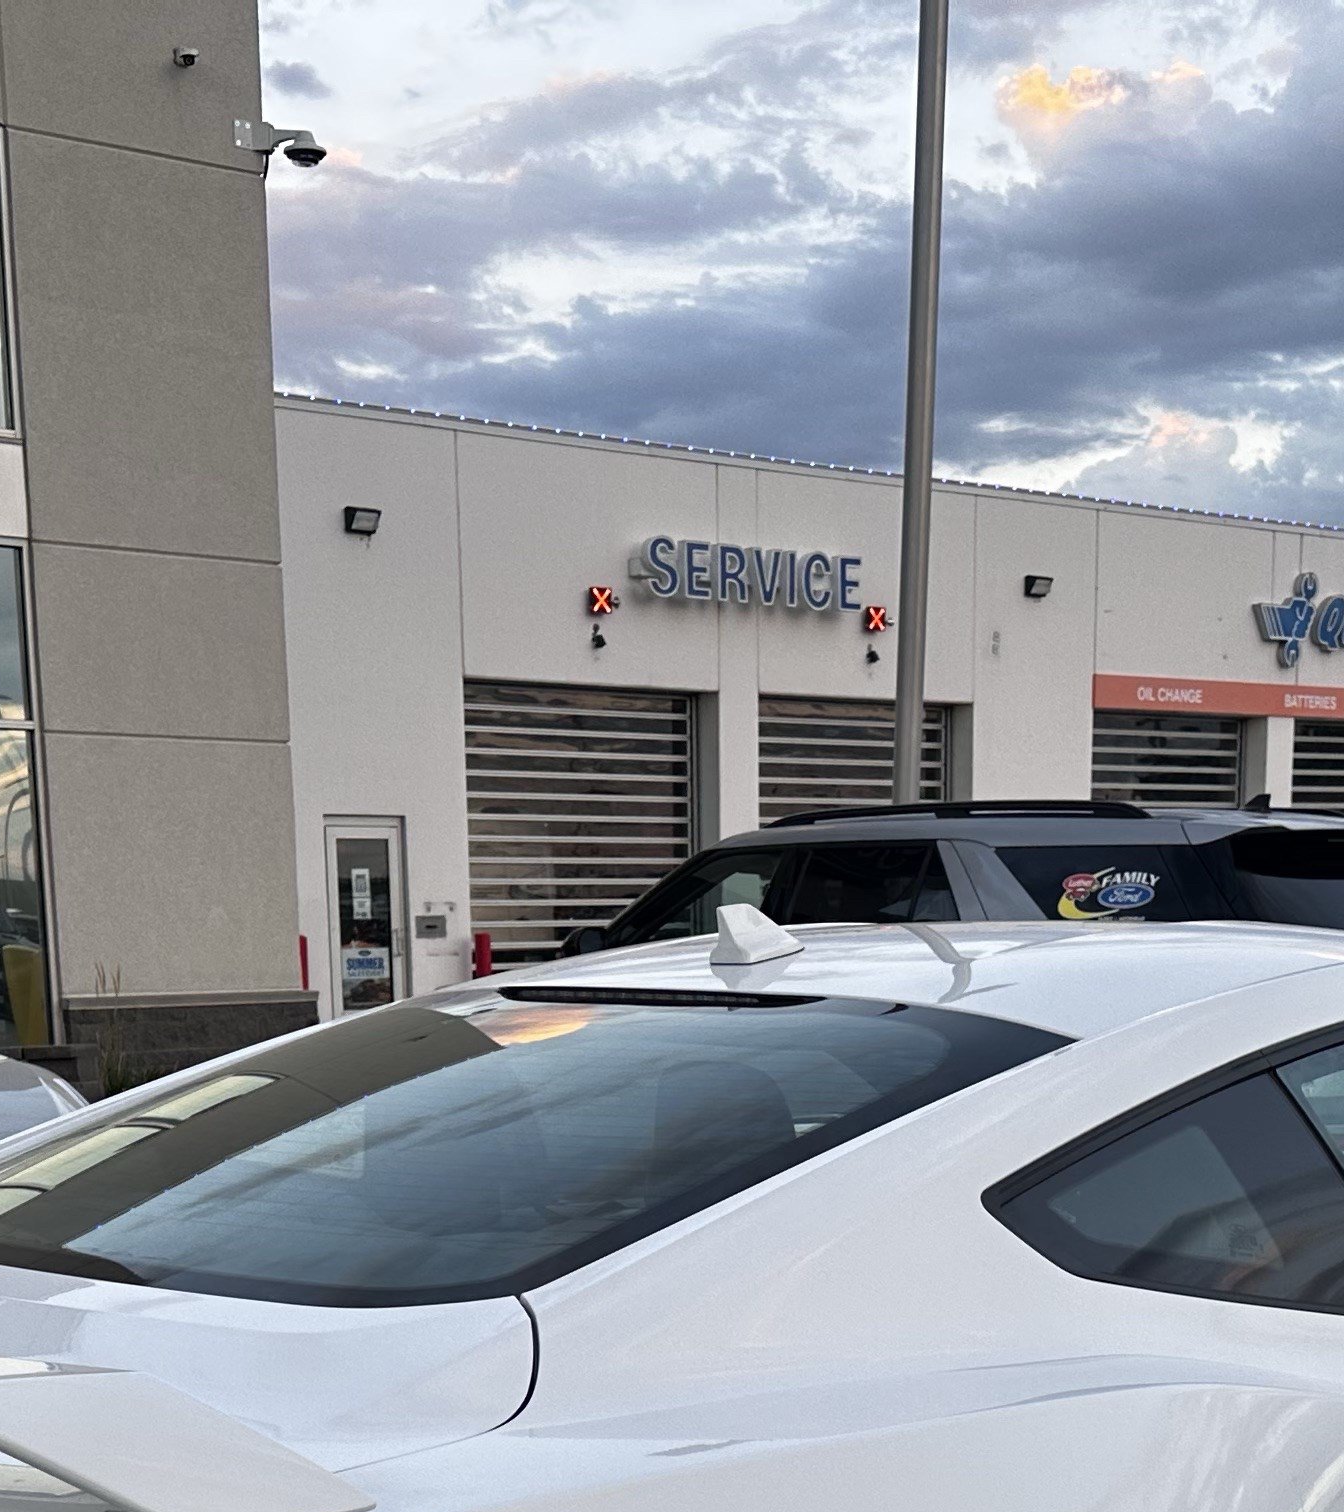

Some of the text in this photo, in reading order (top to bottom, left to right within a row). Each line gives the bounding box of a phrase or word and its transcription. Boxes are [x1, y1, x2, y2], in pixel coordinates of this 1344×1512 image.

[647, 535, 862, 612] SERVICE
[1137, 687, 1203, 704] OIL CHANGE
[1284, 694, 1337, 710] BATTERIES
[1101, 871, 1160, 888] FAMILY
[1109, 887, 1143, 903] Ford
